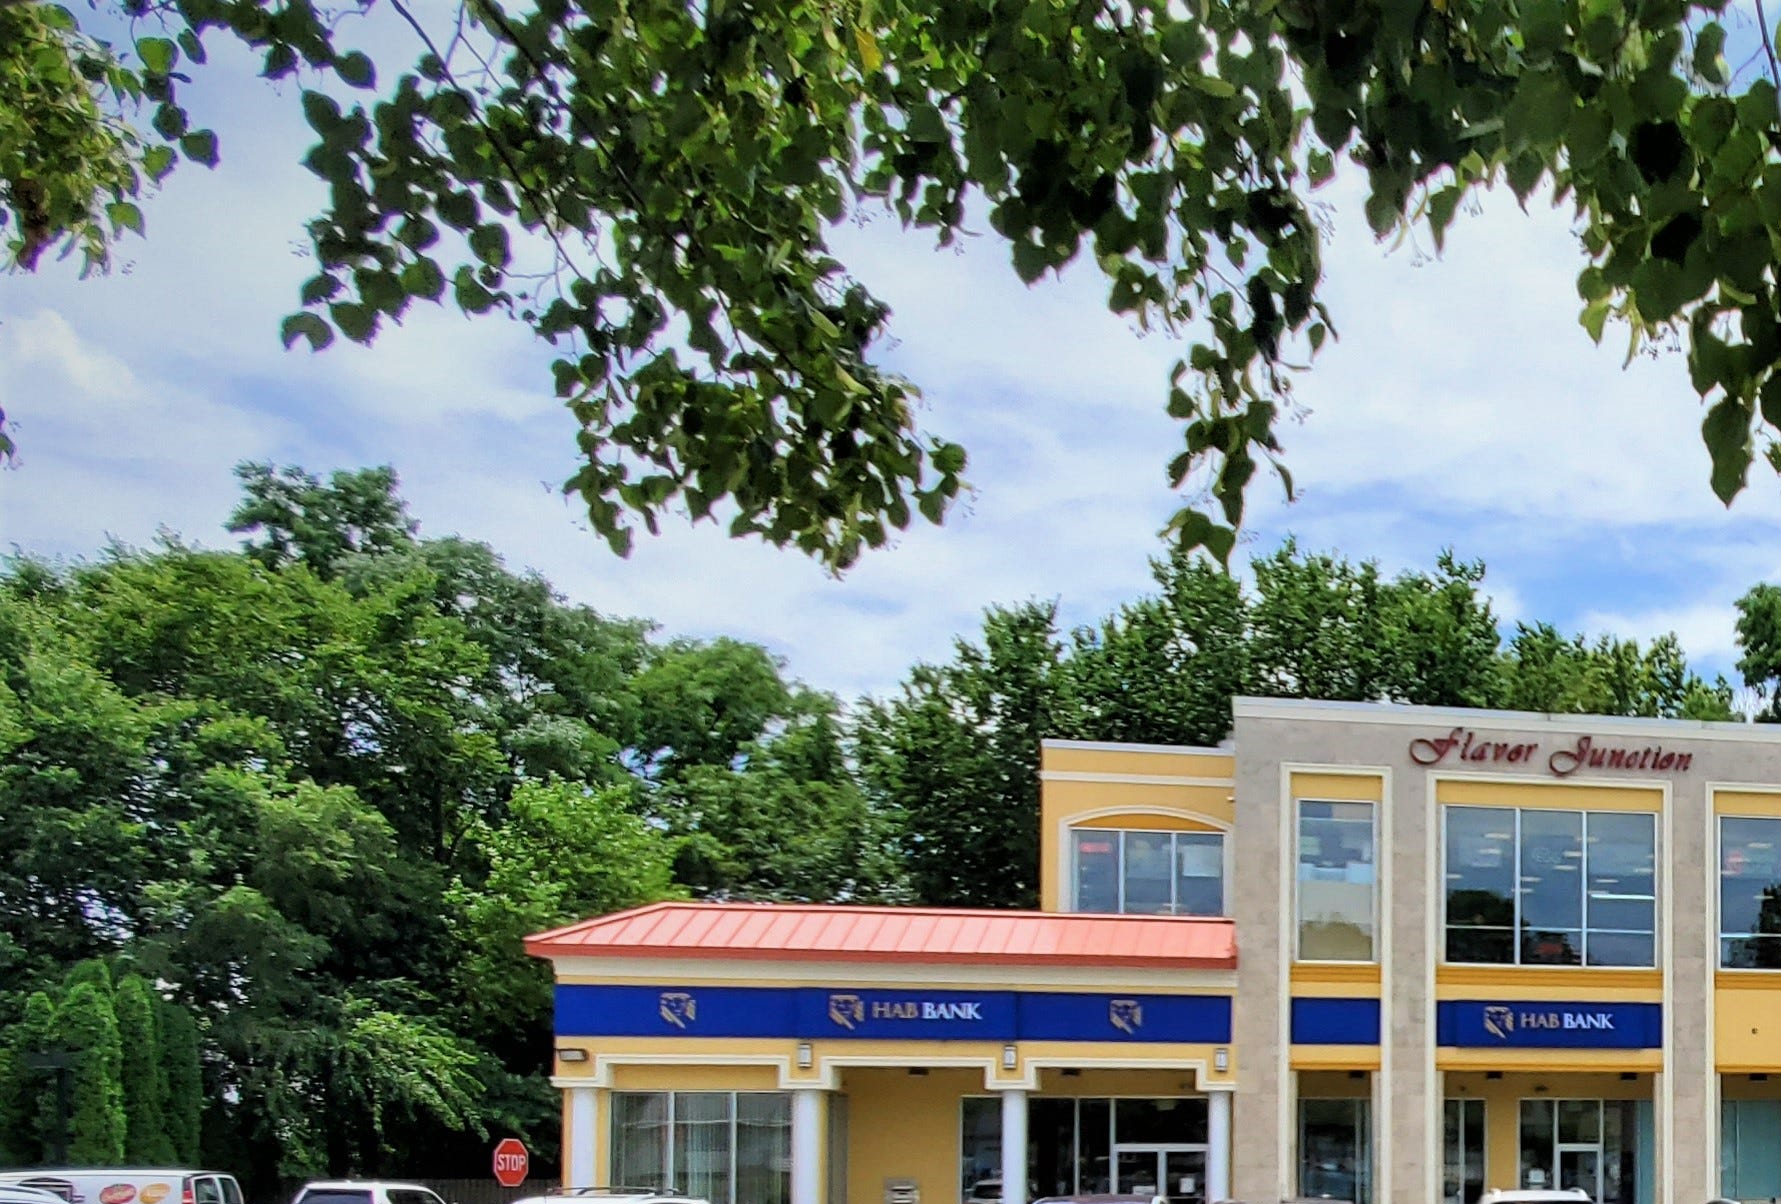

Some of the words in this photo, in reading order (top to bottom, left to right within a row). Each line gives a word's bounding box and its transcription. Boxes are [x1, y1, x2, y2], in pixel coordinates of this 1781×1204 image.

[1409, 727, 1538, 765] Flavor
[1549, 735, 1693, 777] Junction
[872, 1001, 918, 1019] HAB
[922, 1003, 982, 1020] BANK
[1520, 1013, 1560, 1028] HAB
[1563, 1013, 1615, 1029] BANK
[498, 1154, 526, 1171] STOP
